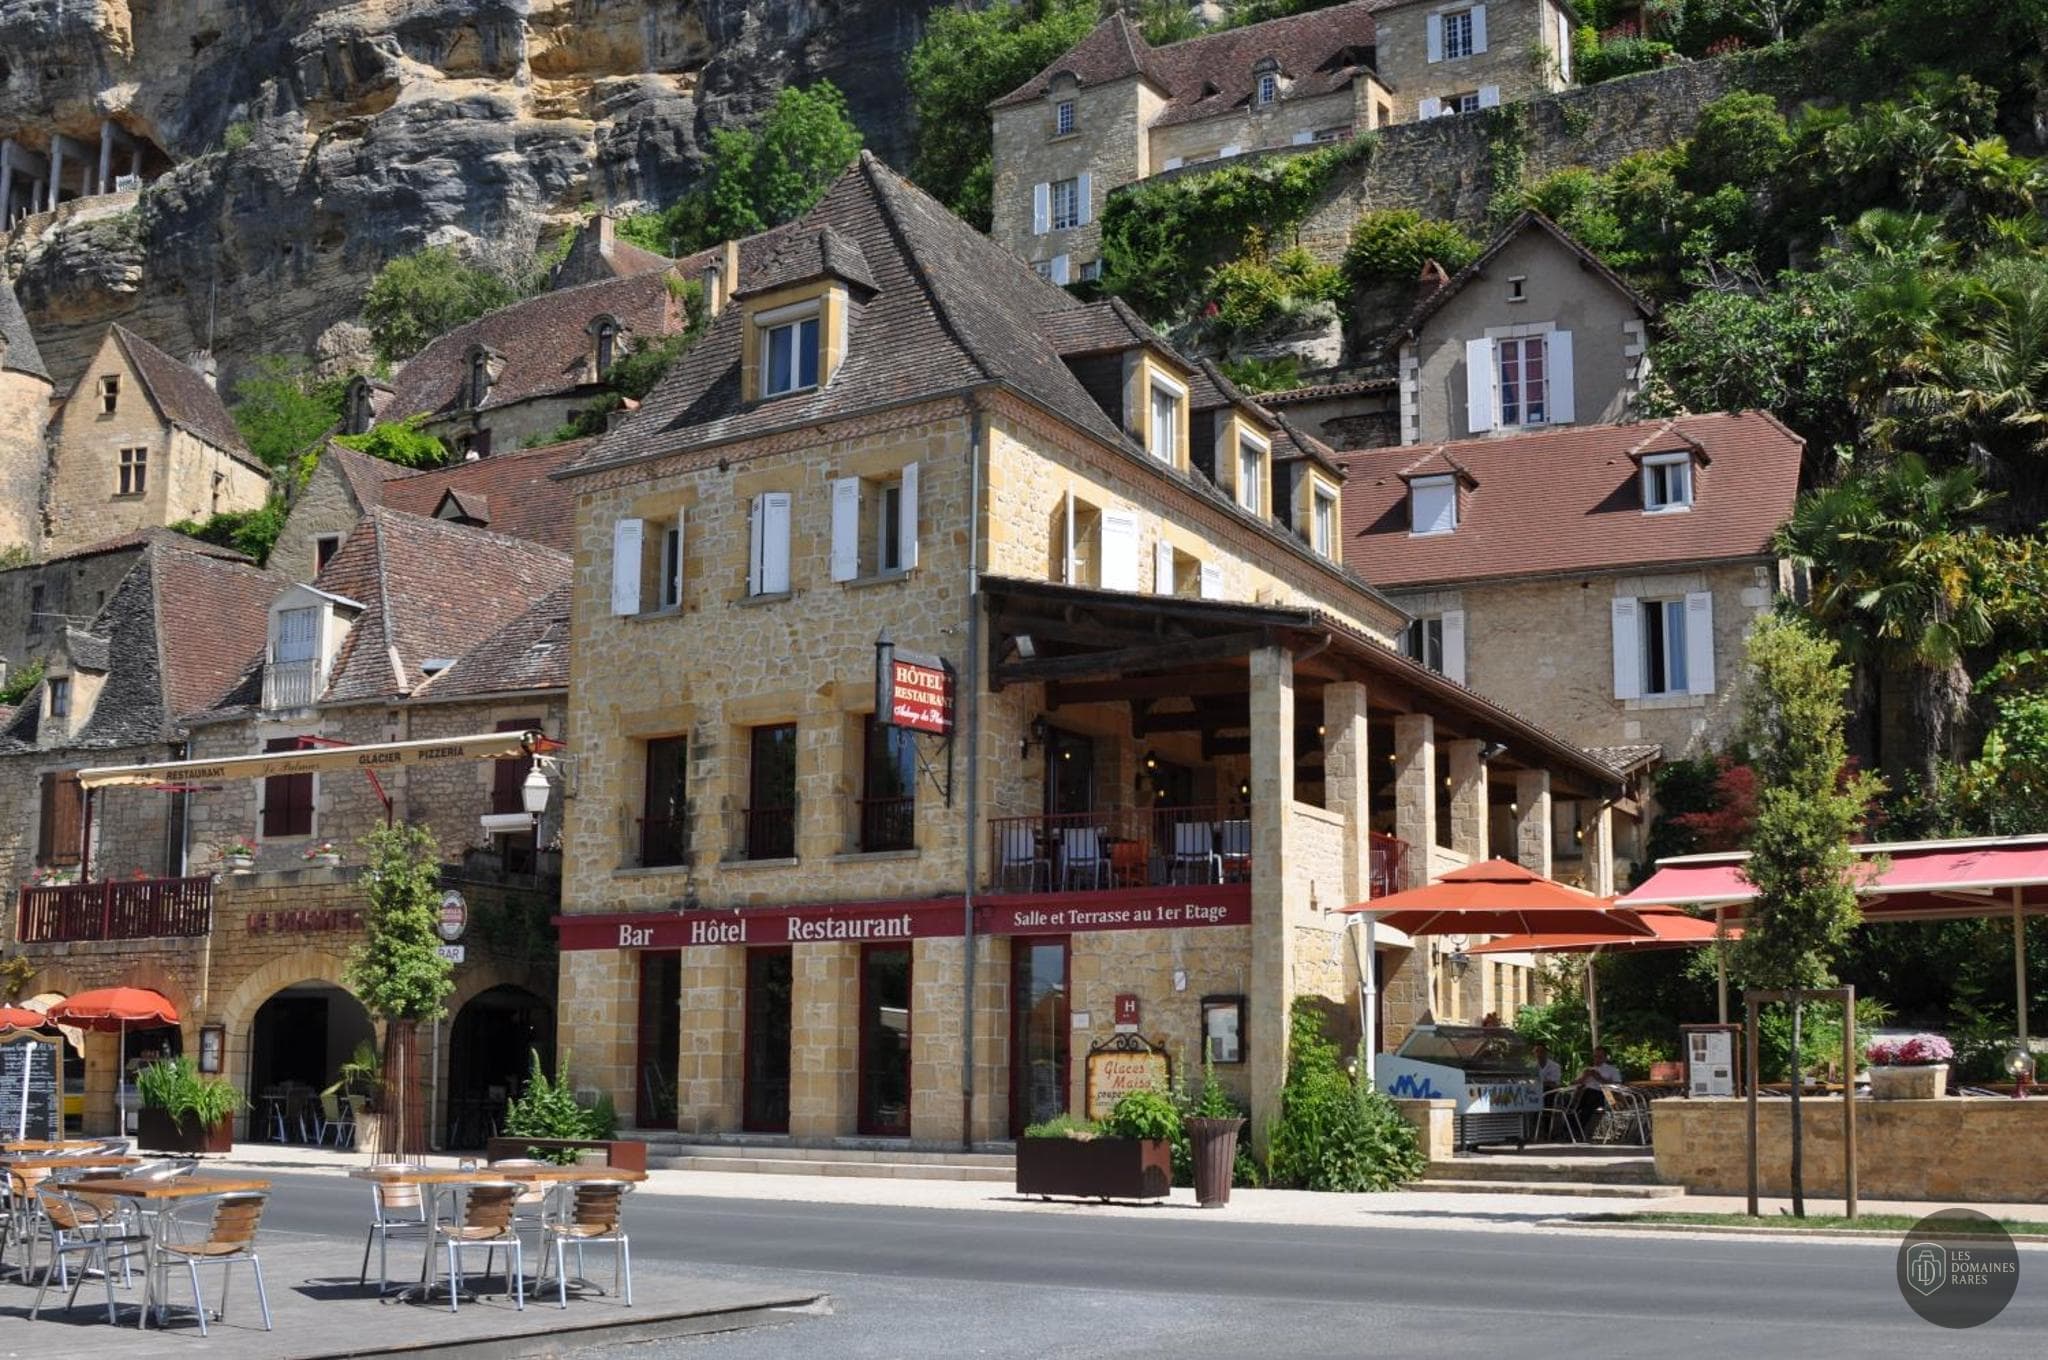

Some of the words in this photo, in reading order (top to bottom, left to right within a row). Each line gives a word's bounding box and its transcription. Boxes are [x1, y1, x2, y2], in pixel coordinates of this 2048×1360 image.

[896, 666, 943, 690] HÔTEL
[894, 686, 953, 708] RESTAURANT
[166, 767, 225, 781] RESTAURANT
[358, 751, 401, 765] GLACIER
[418, 745, 464, 760] PIZZERIA
[1014, 910, 1047, 926] Salle
[1051, 911, 1065, 925] et
[1068, 908, 1130, 925] Terrasse
[1133, 908, 1152, 922] au
[1157, 905, 1180, 921] 1er
[1185, 903, 1228, 922] Etage
[619, 924, 653, 947] Bar
[692, 918, 747, 944] Hôtel
[787, 913, 912, 941] Restaurant
[1125, 1000, 1136, 1012] H
[1104, 1060, 1145, 1080] Glaces
[1111, 1075, 1153, 1090] Maiso
